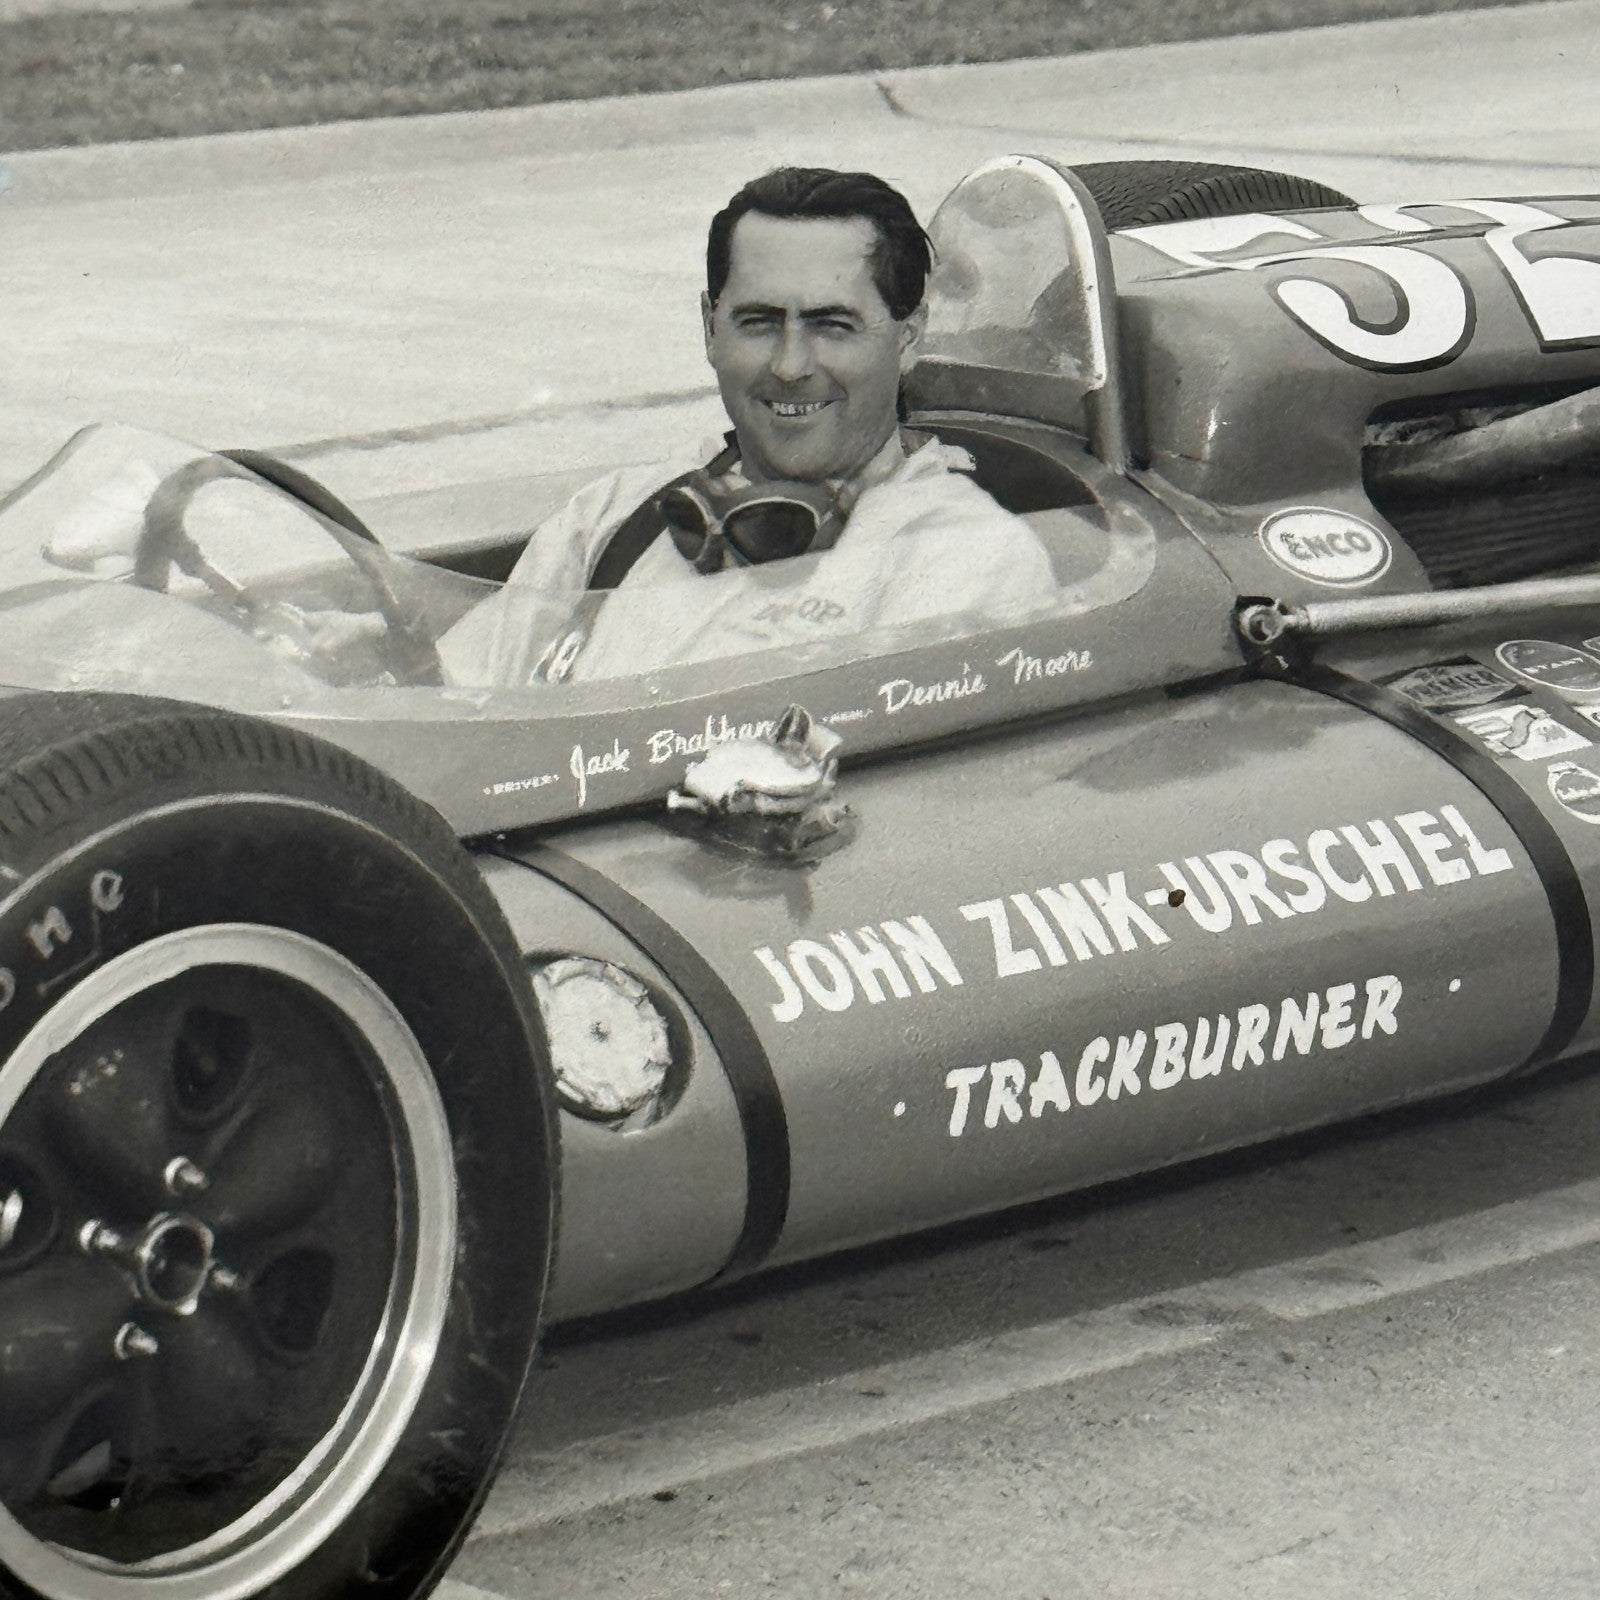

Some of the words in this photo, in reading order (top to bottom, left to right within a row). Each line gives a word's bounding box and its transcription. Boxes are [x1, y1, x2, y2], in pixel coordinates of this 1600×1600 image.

[570, 738, 631, 808] Jack
[878, 661, 988, 714] Dennie
[753, 915, 963, 1022] JOHN
[945, 974, 1402, 1137] TRACKBURNER
